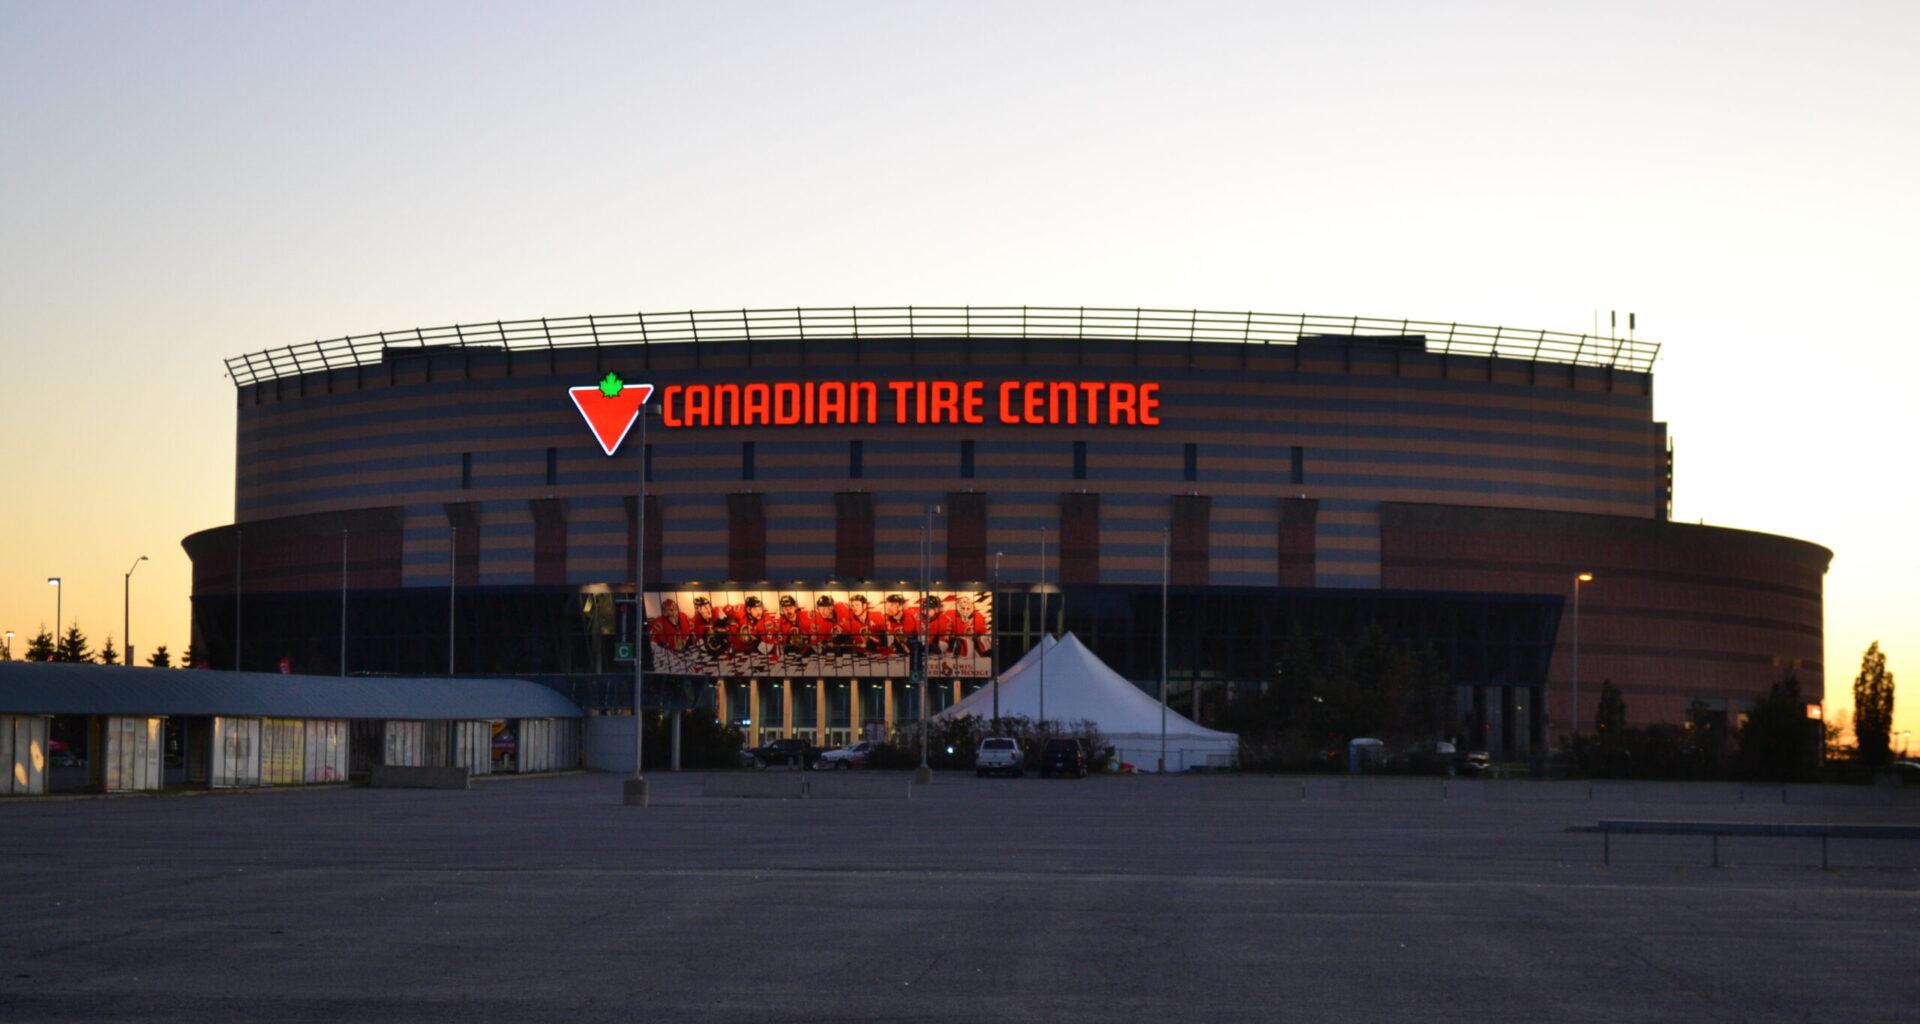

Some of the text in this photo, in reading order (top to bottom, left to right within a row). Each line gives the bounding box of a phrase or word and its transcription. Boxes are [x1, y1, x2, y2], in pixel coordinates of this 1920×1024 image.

[662, 380, 1160, 427] CANADIAN TIRE CENTRE
[619, 646, 629, 658] C
